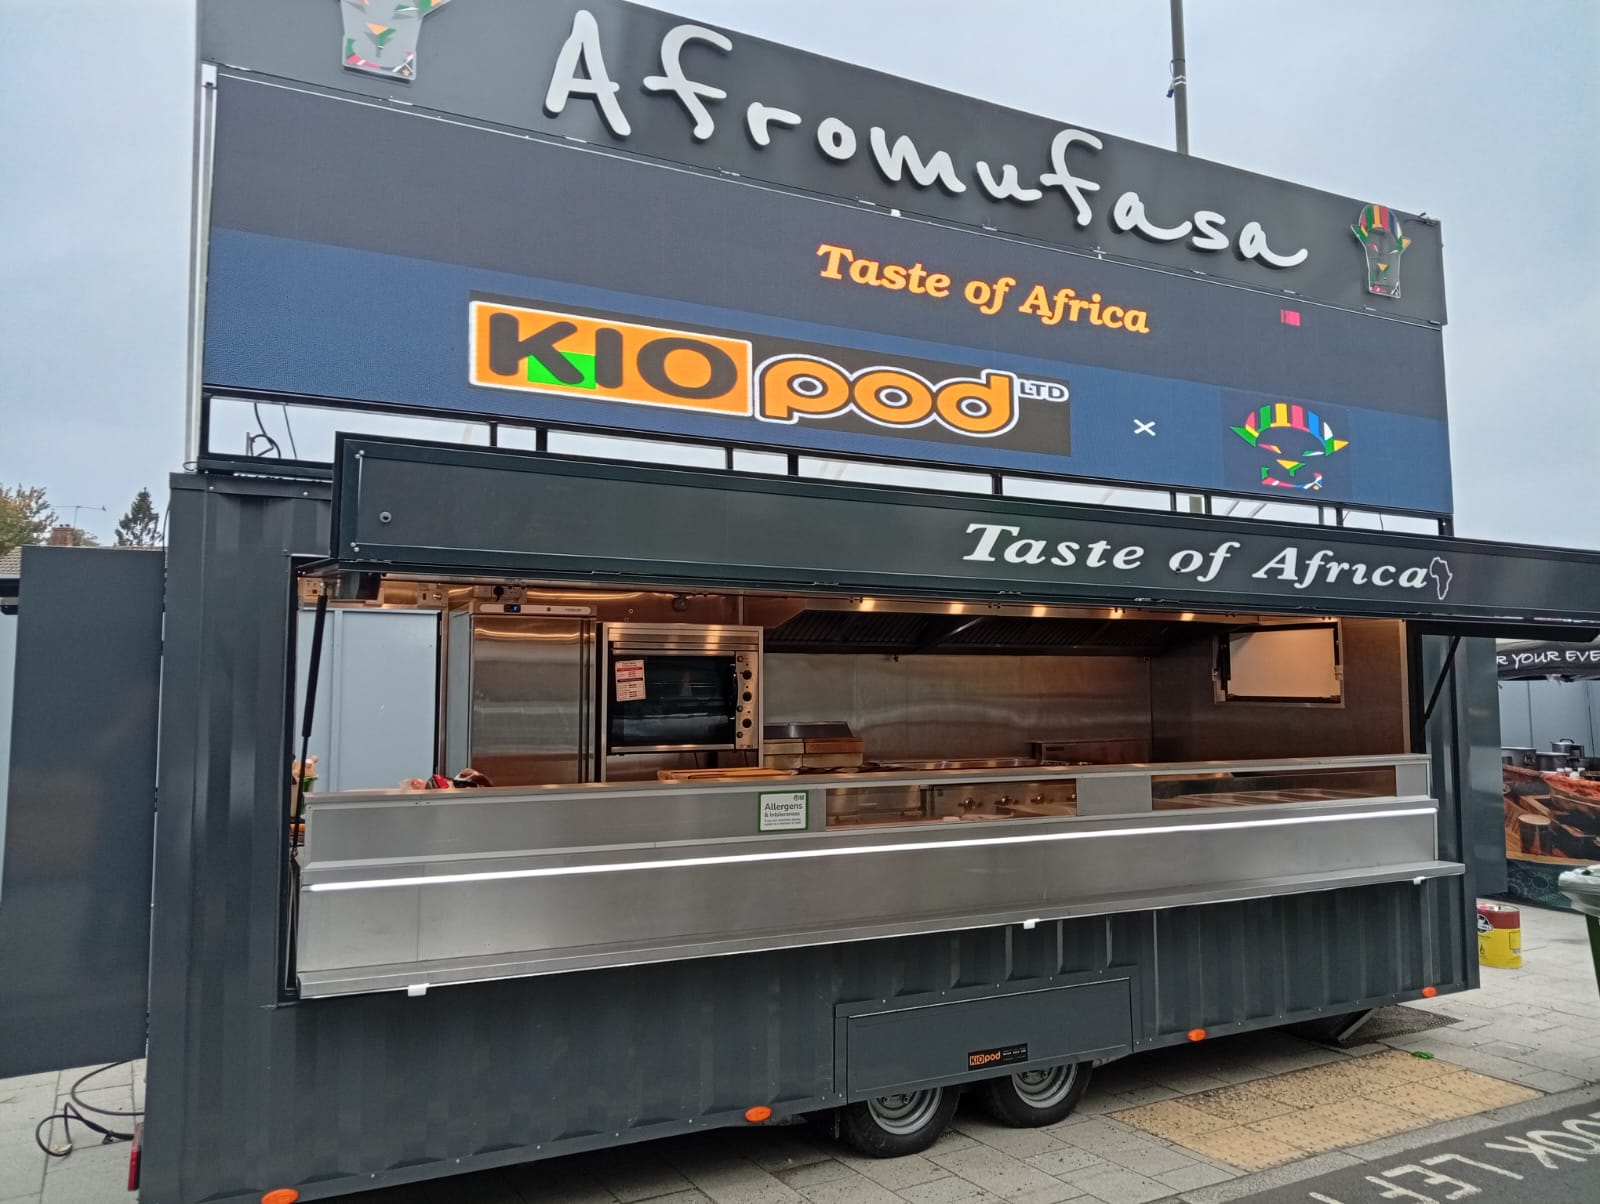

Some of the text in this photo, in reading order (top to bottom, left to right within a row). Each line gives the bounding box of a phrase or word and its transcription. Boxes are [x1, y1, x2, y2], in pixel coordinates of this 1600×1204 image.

[543, 9, 1309, 268] Afromufasa
[816, 242, 1151, 335] Taste of Africa
[1019, 378, 1070, 404] LTD
[963, 522, 1145, 570] Taste
[1168, 541, 1241, 583] of
[1511, 651, 1561, 670] YOUR
[764, 803, 803, 811] Allergens
